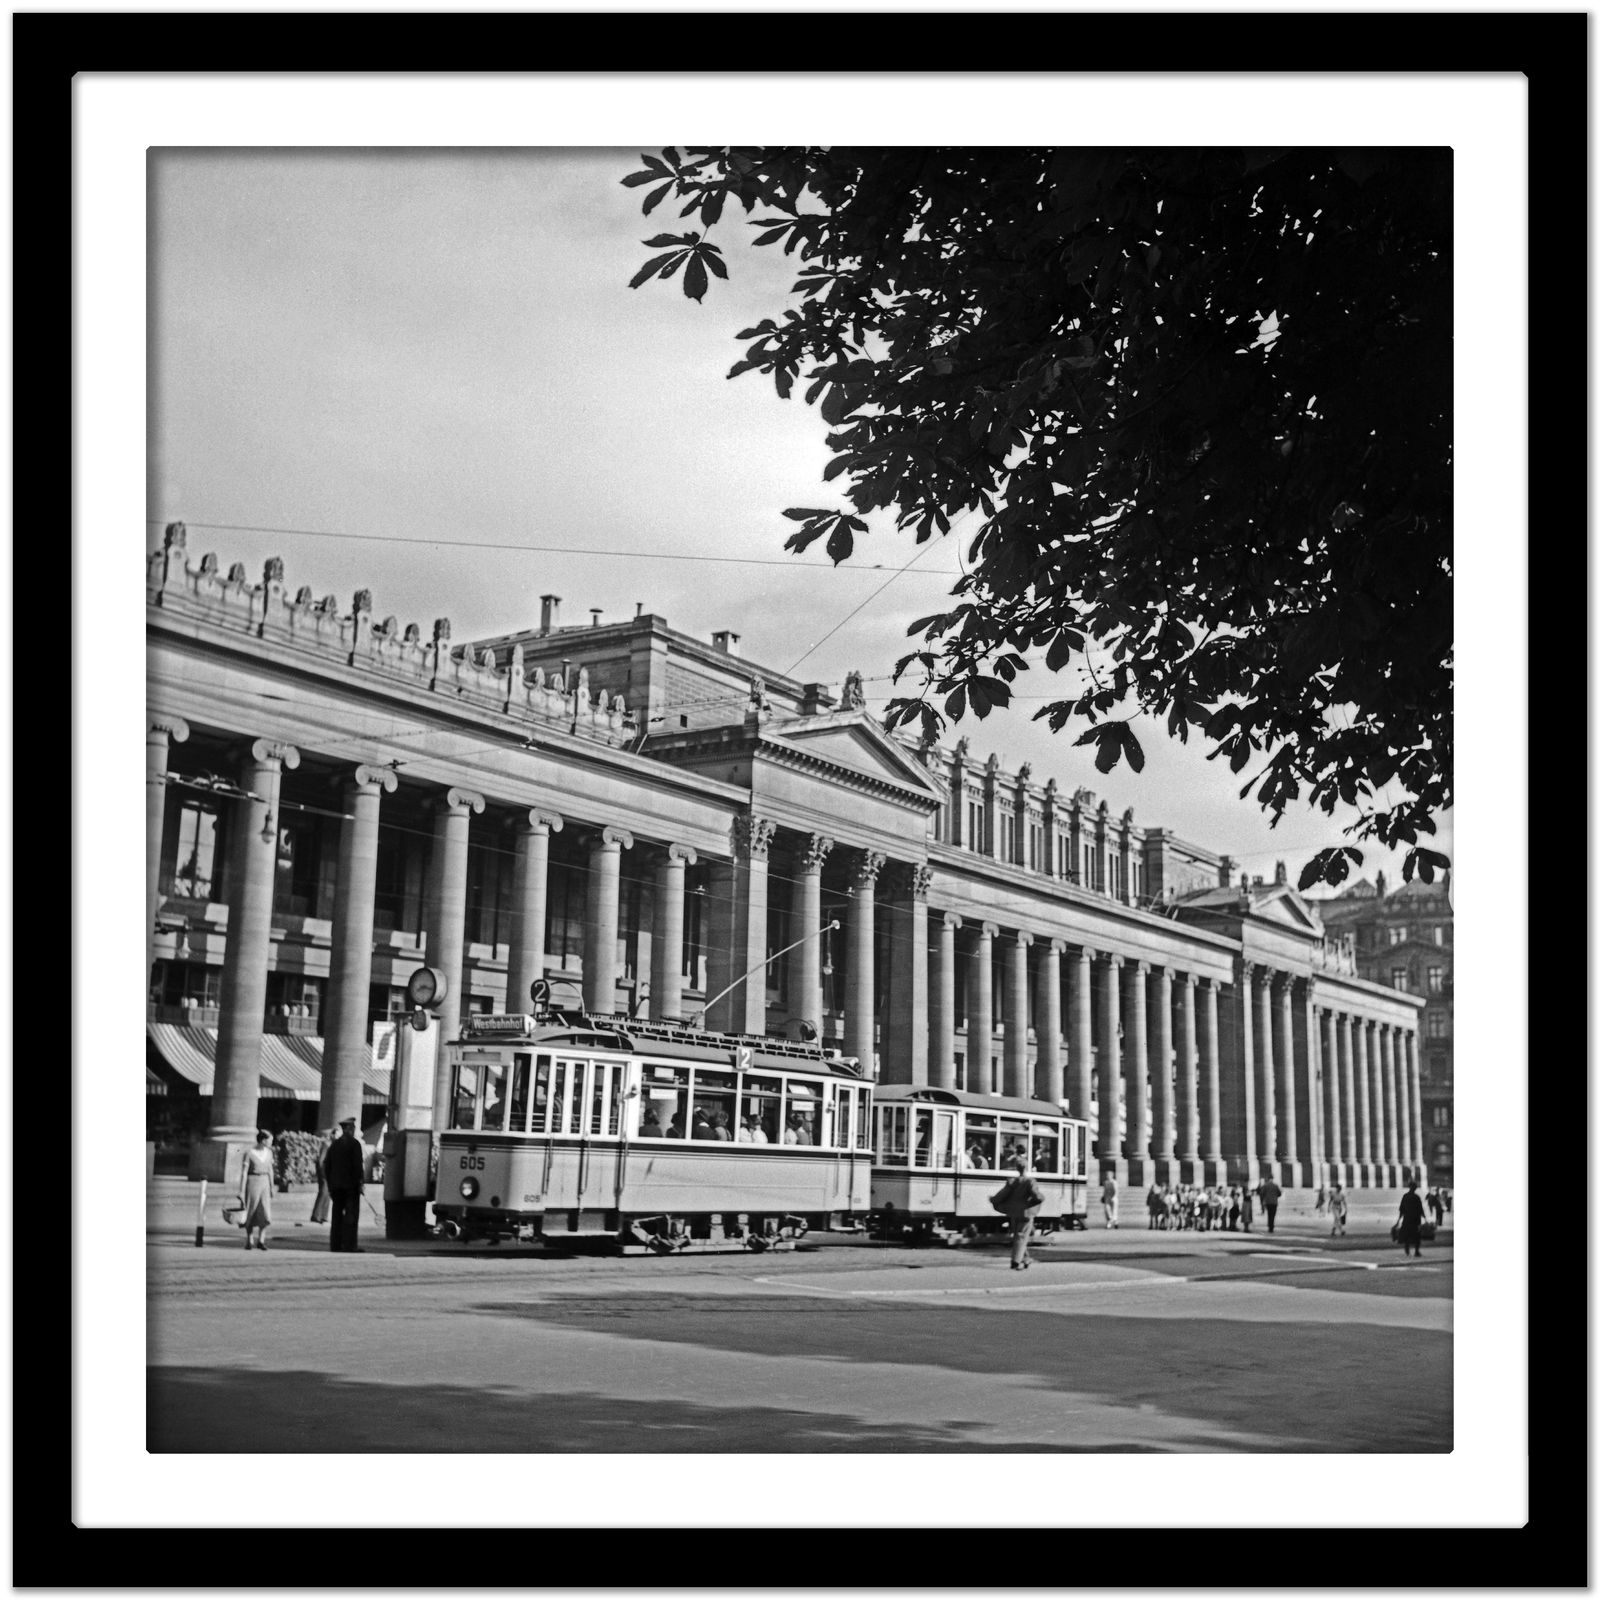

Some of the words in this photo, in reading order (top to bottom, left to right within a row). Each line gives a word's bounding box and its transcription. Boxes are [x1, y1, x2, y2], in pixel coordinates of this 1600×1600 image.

[534, 981, 546, 1001] 2
[473, 1017, 522, 1030] Westbahnhof
[741, 1048, 750, 1068] 2
[460, 1156, 485, 1170] 605
